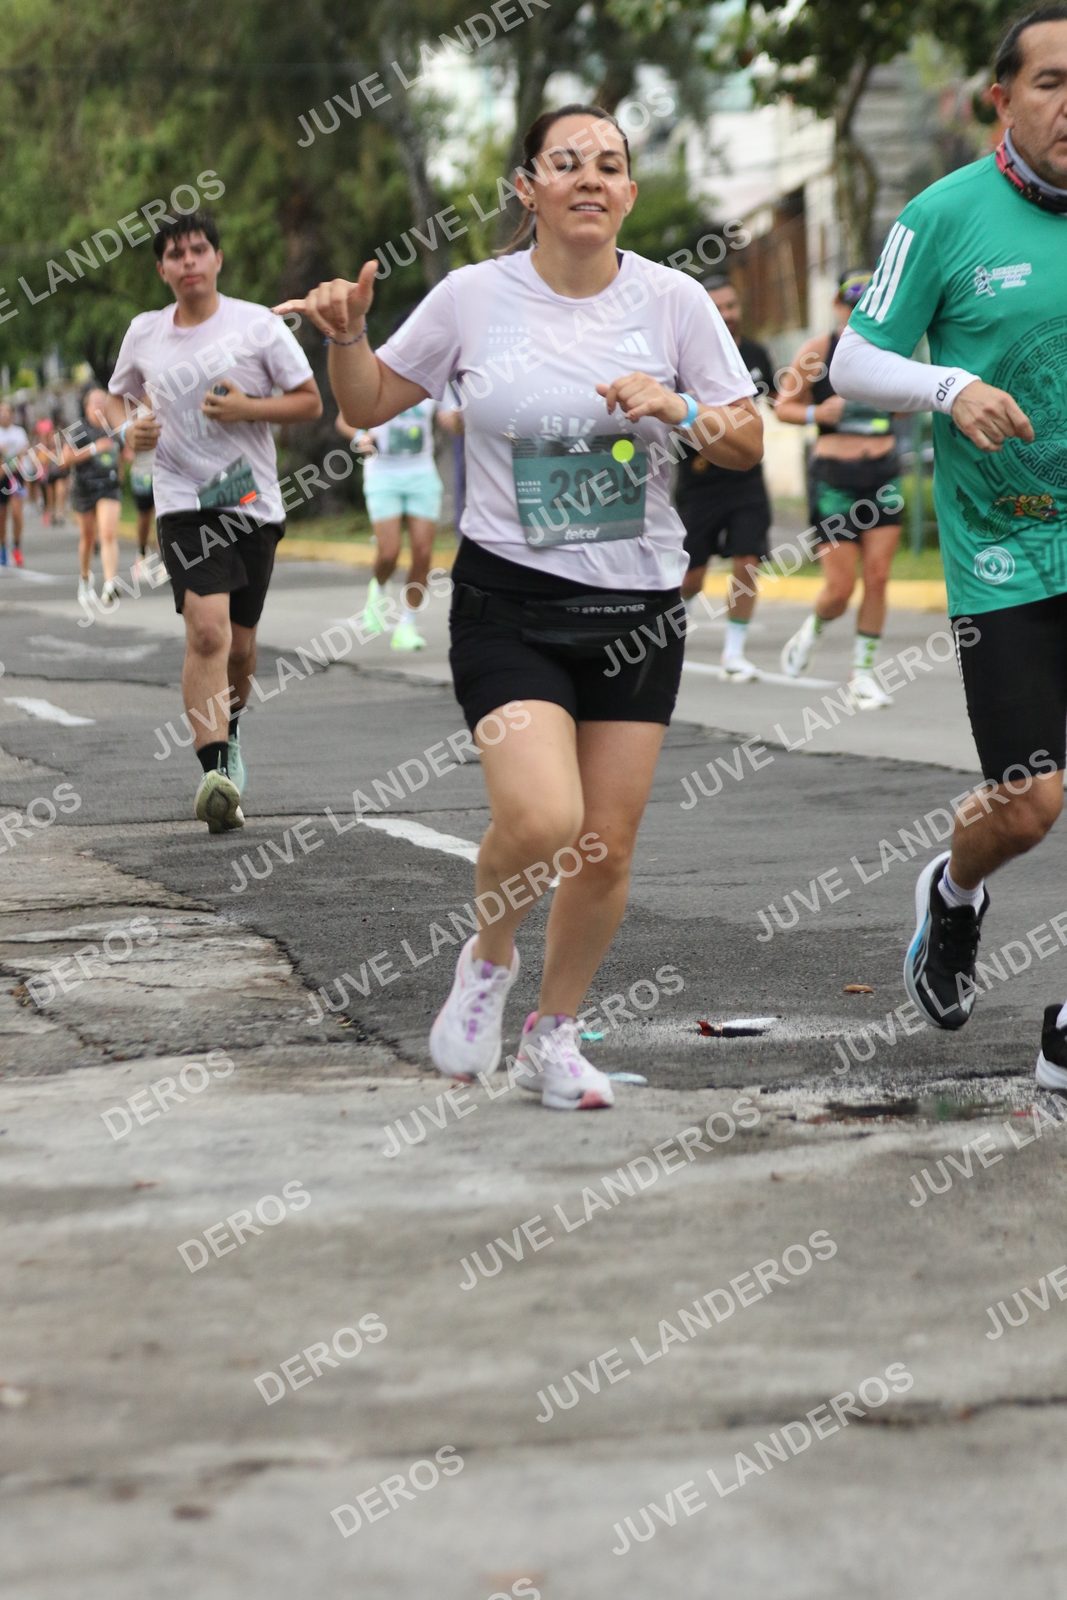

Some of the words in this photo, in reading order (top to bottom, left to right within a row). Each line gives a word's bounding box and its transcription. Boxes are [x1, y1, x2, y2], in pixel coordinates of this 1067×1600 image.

[936, 376, 956, 402] alo
[564, 527, 600, 540] telcel
[604, 604, 646, 614] RUNNER
